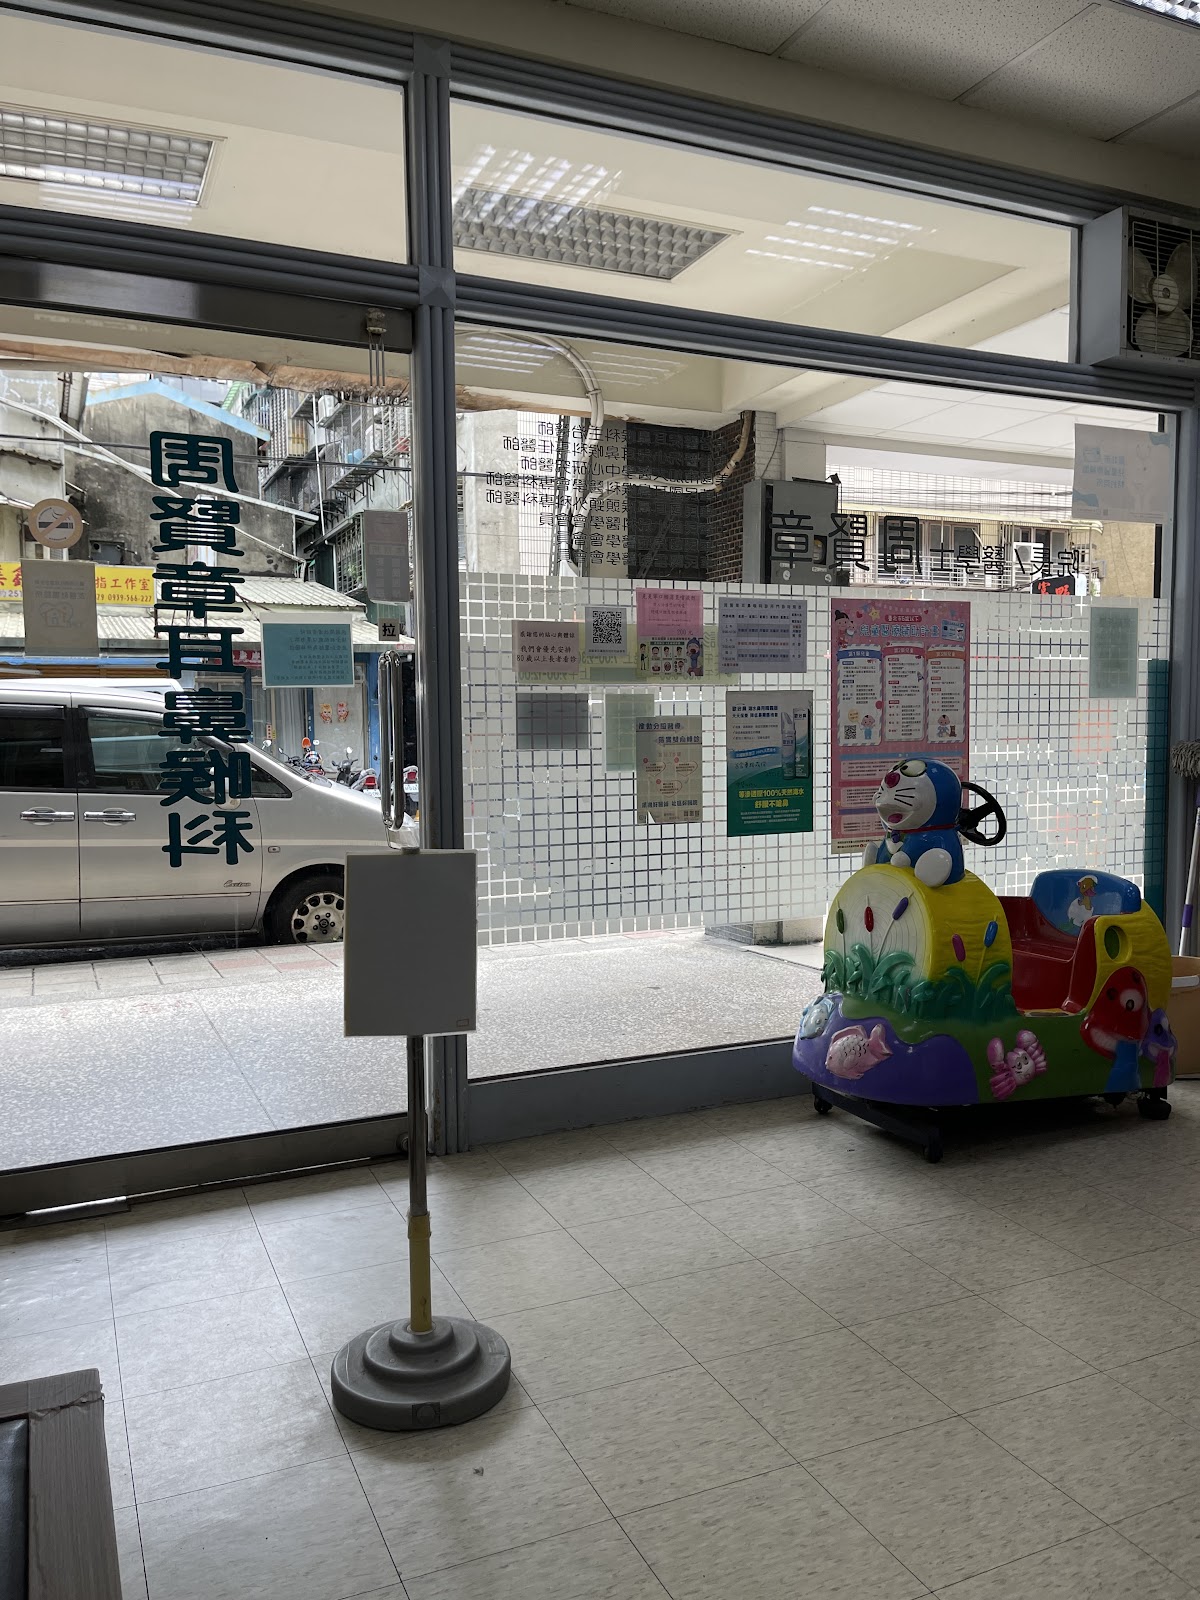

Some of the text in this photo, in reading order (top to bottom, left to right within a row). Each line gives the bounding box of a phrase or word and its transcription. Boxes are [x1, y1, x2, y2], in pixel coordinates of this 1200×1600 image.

[95, 576, 150, 591] 指工作室
[382, 623, 396, 637] 拉
[521, 645, 572, 654] 我們會優先安排
